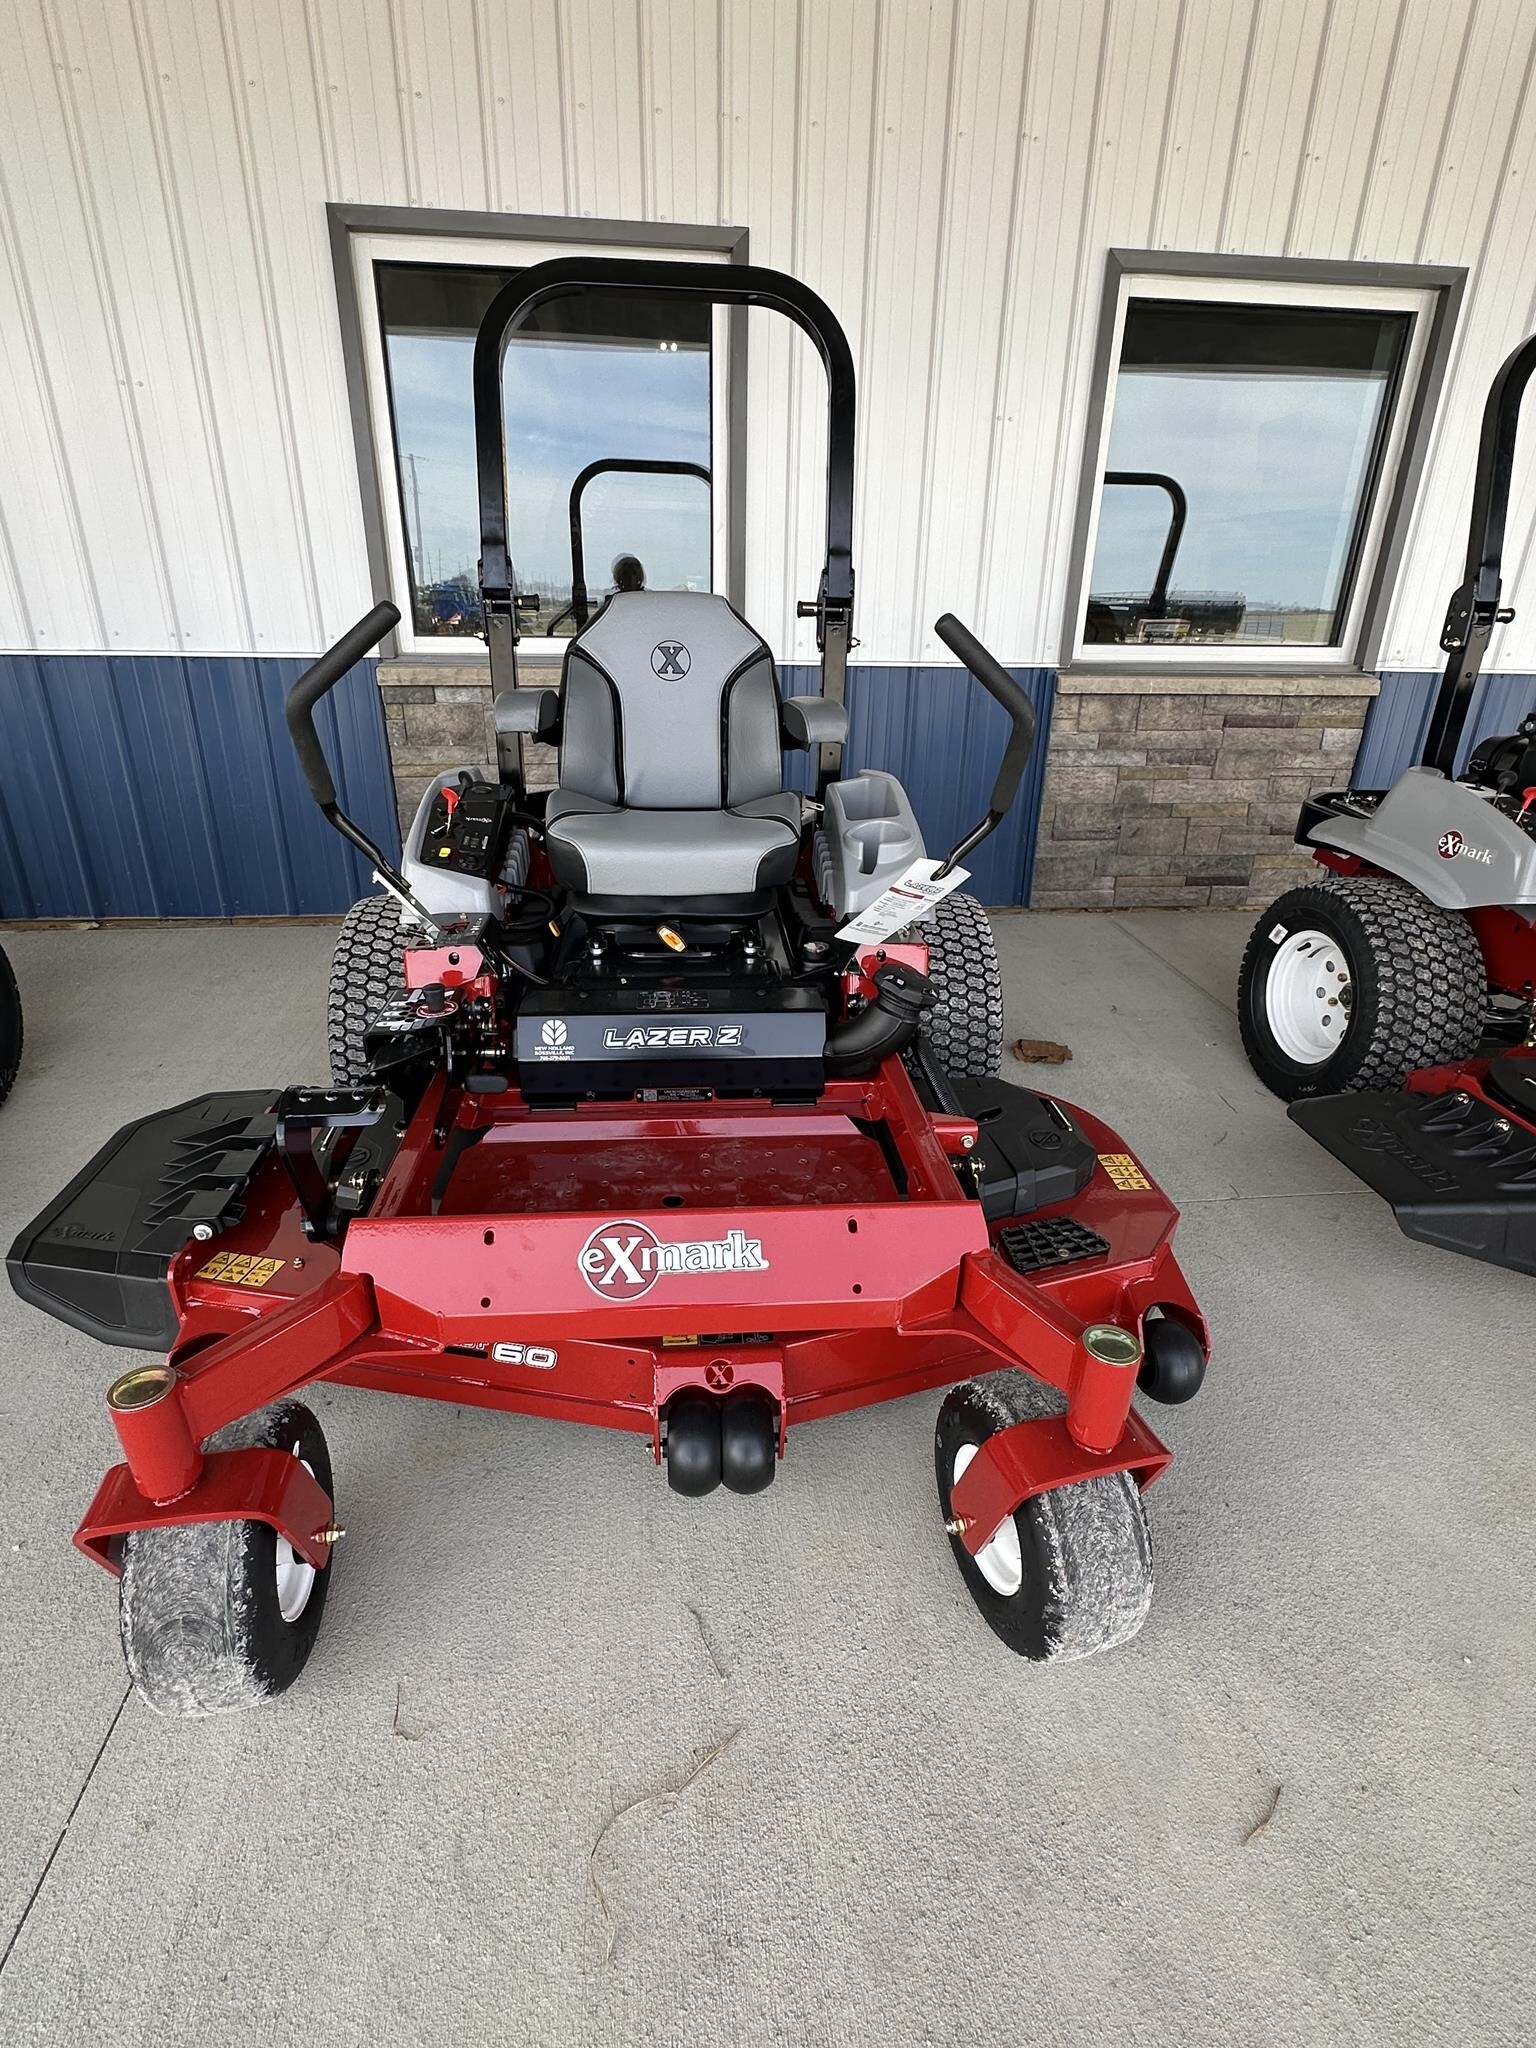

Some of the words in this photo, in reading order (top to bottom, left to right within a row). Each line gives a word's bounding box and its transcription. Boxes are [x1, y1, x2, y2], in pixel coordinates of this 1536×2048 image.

[657, 646, 686, 674] X
[1438, 833, 1493, 865] eXmark
[603, 1027, 713, 1049] LAZER
[715, 1025, 743, 1047] Z
[580, 1231, 764, 1287] eXmark
[492, 1341, 558, 1370] 60
